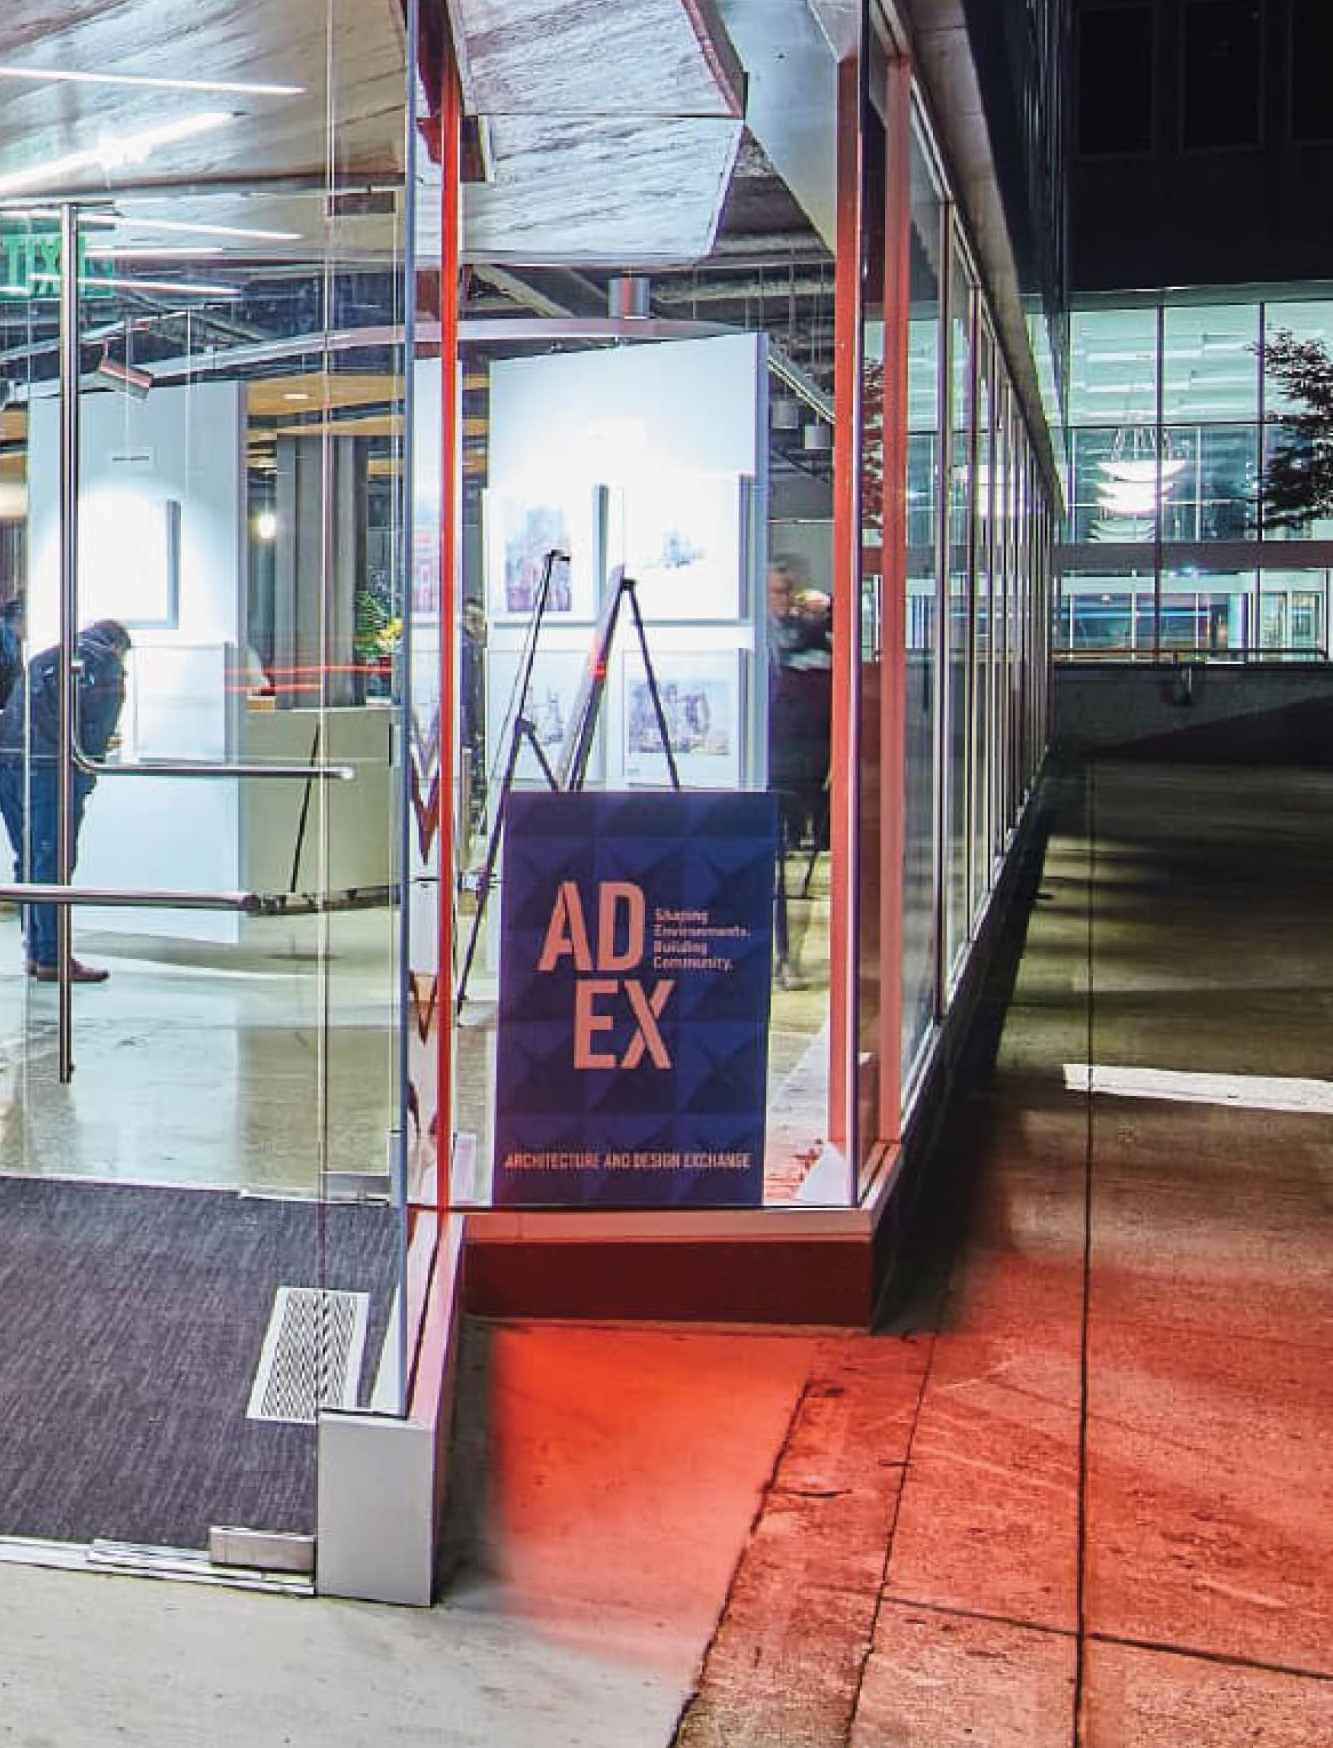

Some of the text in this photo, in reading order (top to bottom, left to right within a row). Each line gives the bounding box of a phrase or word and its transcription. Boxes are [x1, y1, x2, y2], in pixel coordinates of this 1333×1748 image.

[538, 880, 646, 972] AD
[574, 978, 676, 1070] EX
[504, 1151, 753, 1171] ARCHITECTURE AND DESIGN EXCHANGE
